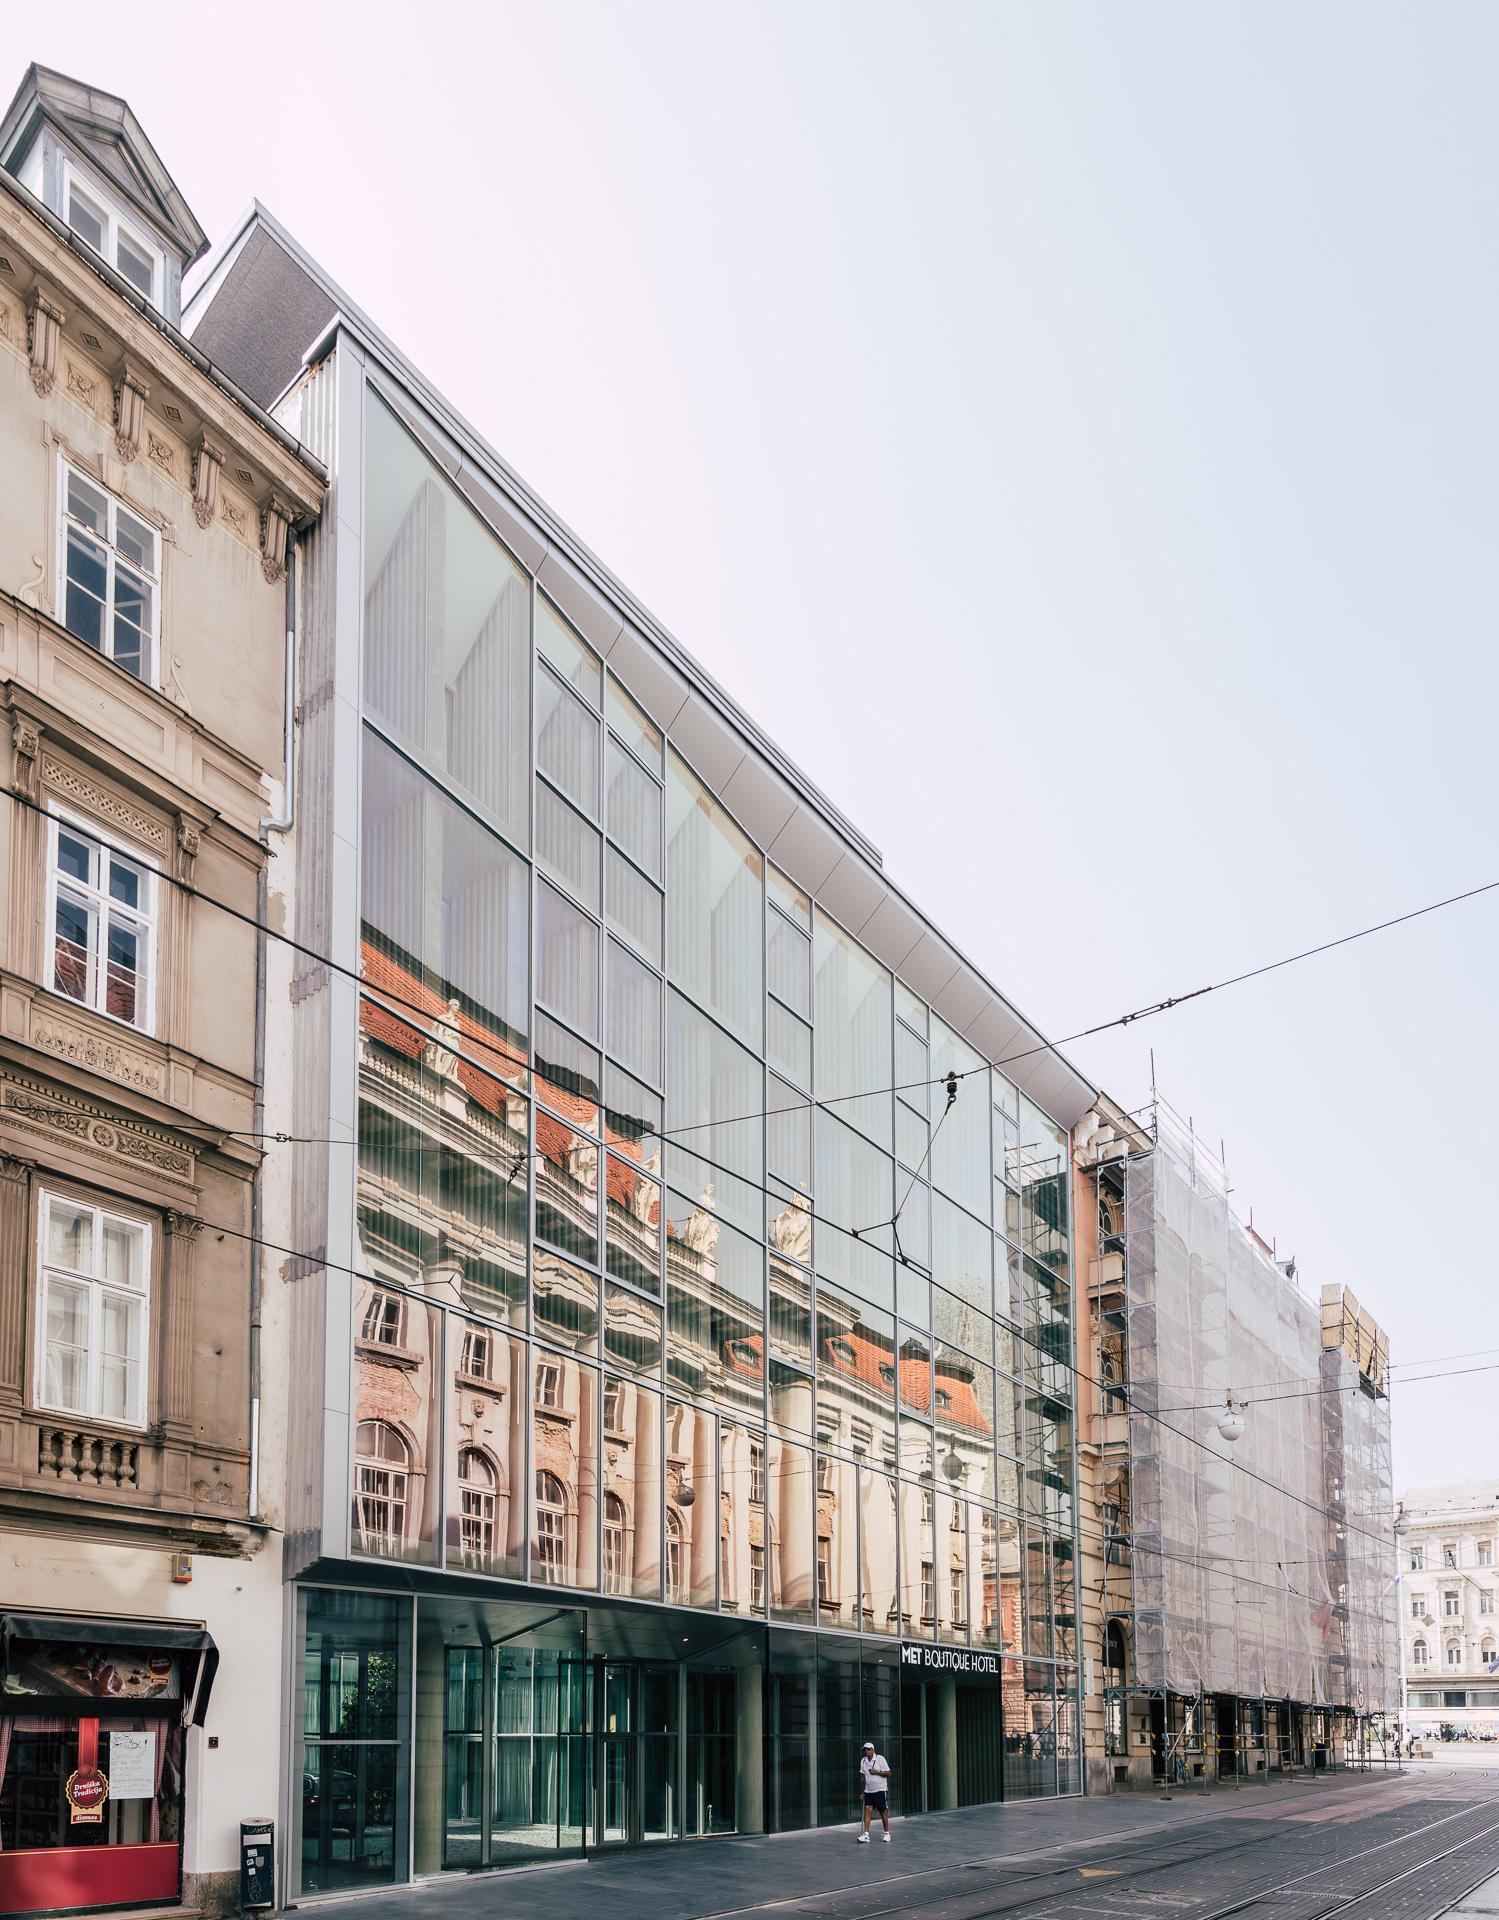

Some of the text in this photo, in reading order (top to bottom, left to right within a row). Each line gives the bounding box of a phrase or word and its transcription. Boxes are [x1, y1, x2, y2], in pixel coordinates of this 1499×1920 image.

[901, 1645, 998, 1673] MET BOUTIQUE HOTEL
[73, 1787, 103, 1798] Tradicija
